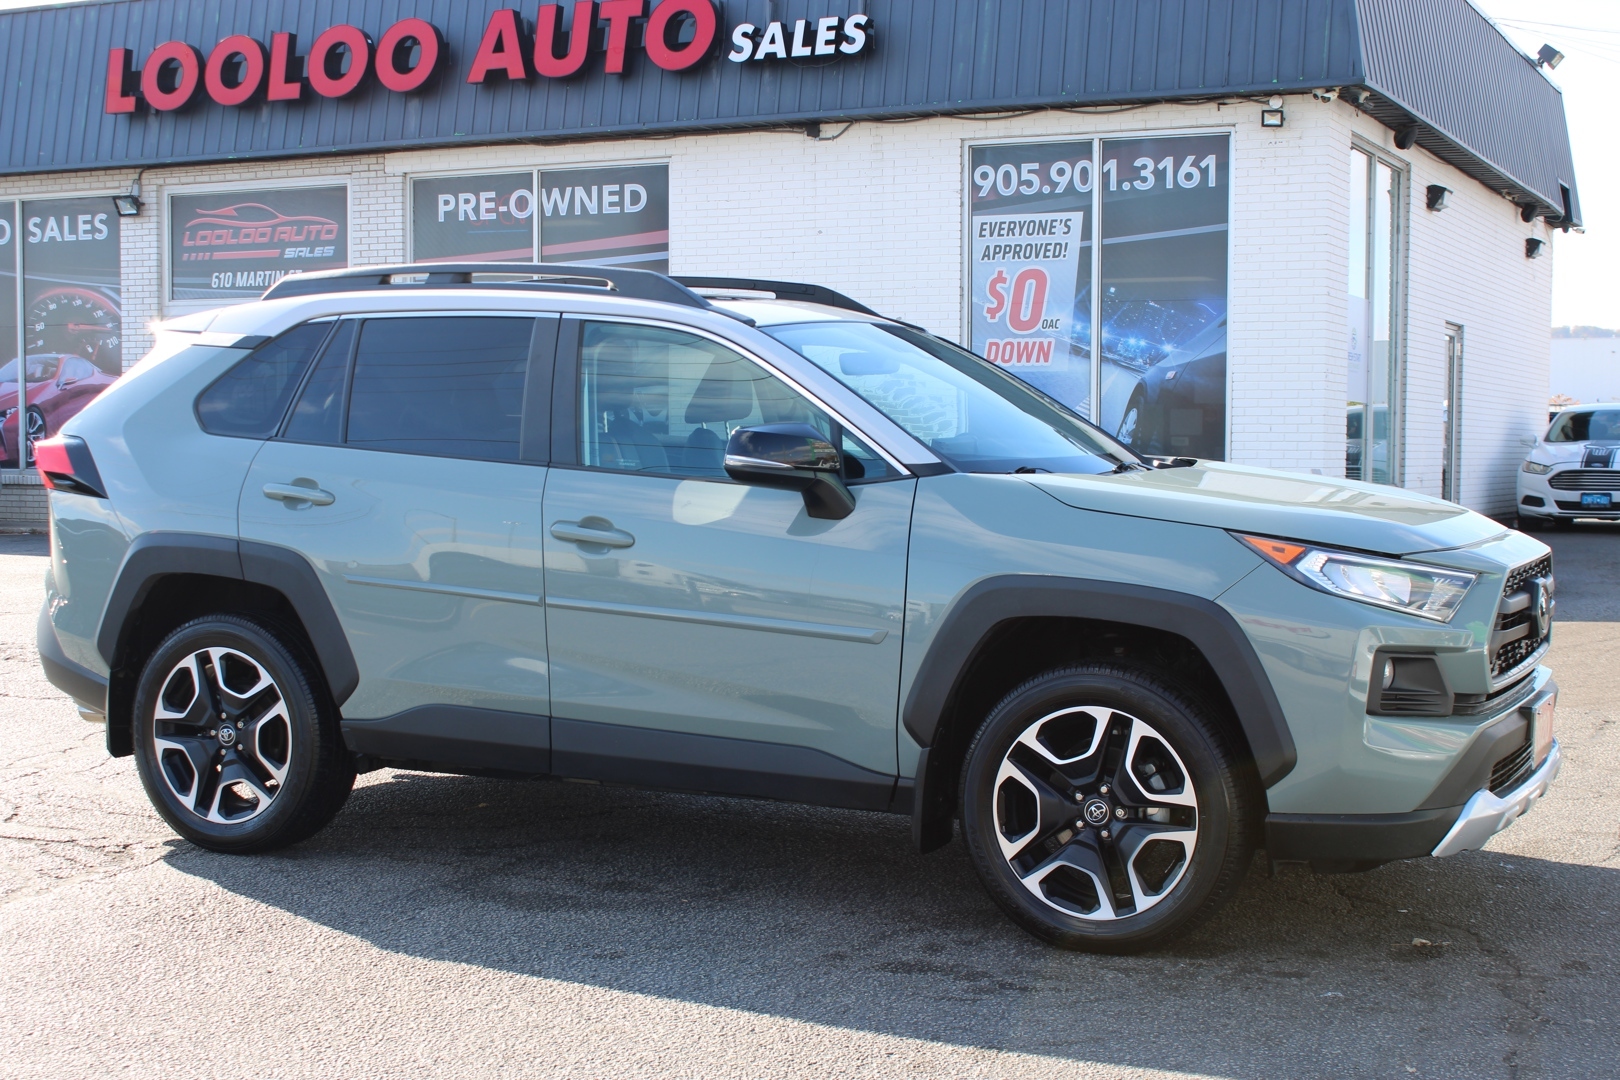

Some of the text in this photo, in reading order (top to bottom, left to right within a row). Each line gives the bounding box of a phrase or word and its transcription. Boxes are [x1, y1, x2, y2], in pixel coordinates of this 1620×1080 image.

[105, 0, 869, 115] LOOLOO AUTO SALES
[973, 154, 1217, 197] 905.901.3161
[437, 183, 648, 223] PRE-OWNED
[28, 213, 108, 244] SALES
[182, 224, 339, 247] LOOLOO AUTO
[978, 218, 1072, 238] EVERYONE'S
[283, 246, 335, 259] SALES
[981, 242, 1069, 261] APPROVED!
[211, 271, 233, 288] 610
[985, 268, 1048, 332] $0
[35, 322, 45, 332] 50
[1041, 318, 1060, 330] OAC
[106, 336, 119, 349] 210
[985, 340, 1053, 364] DOWN
